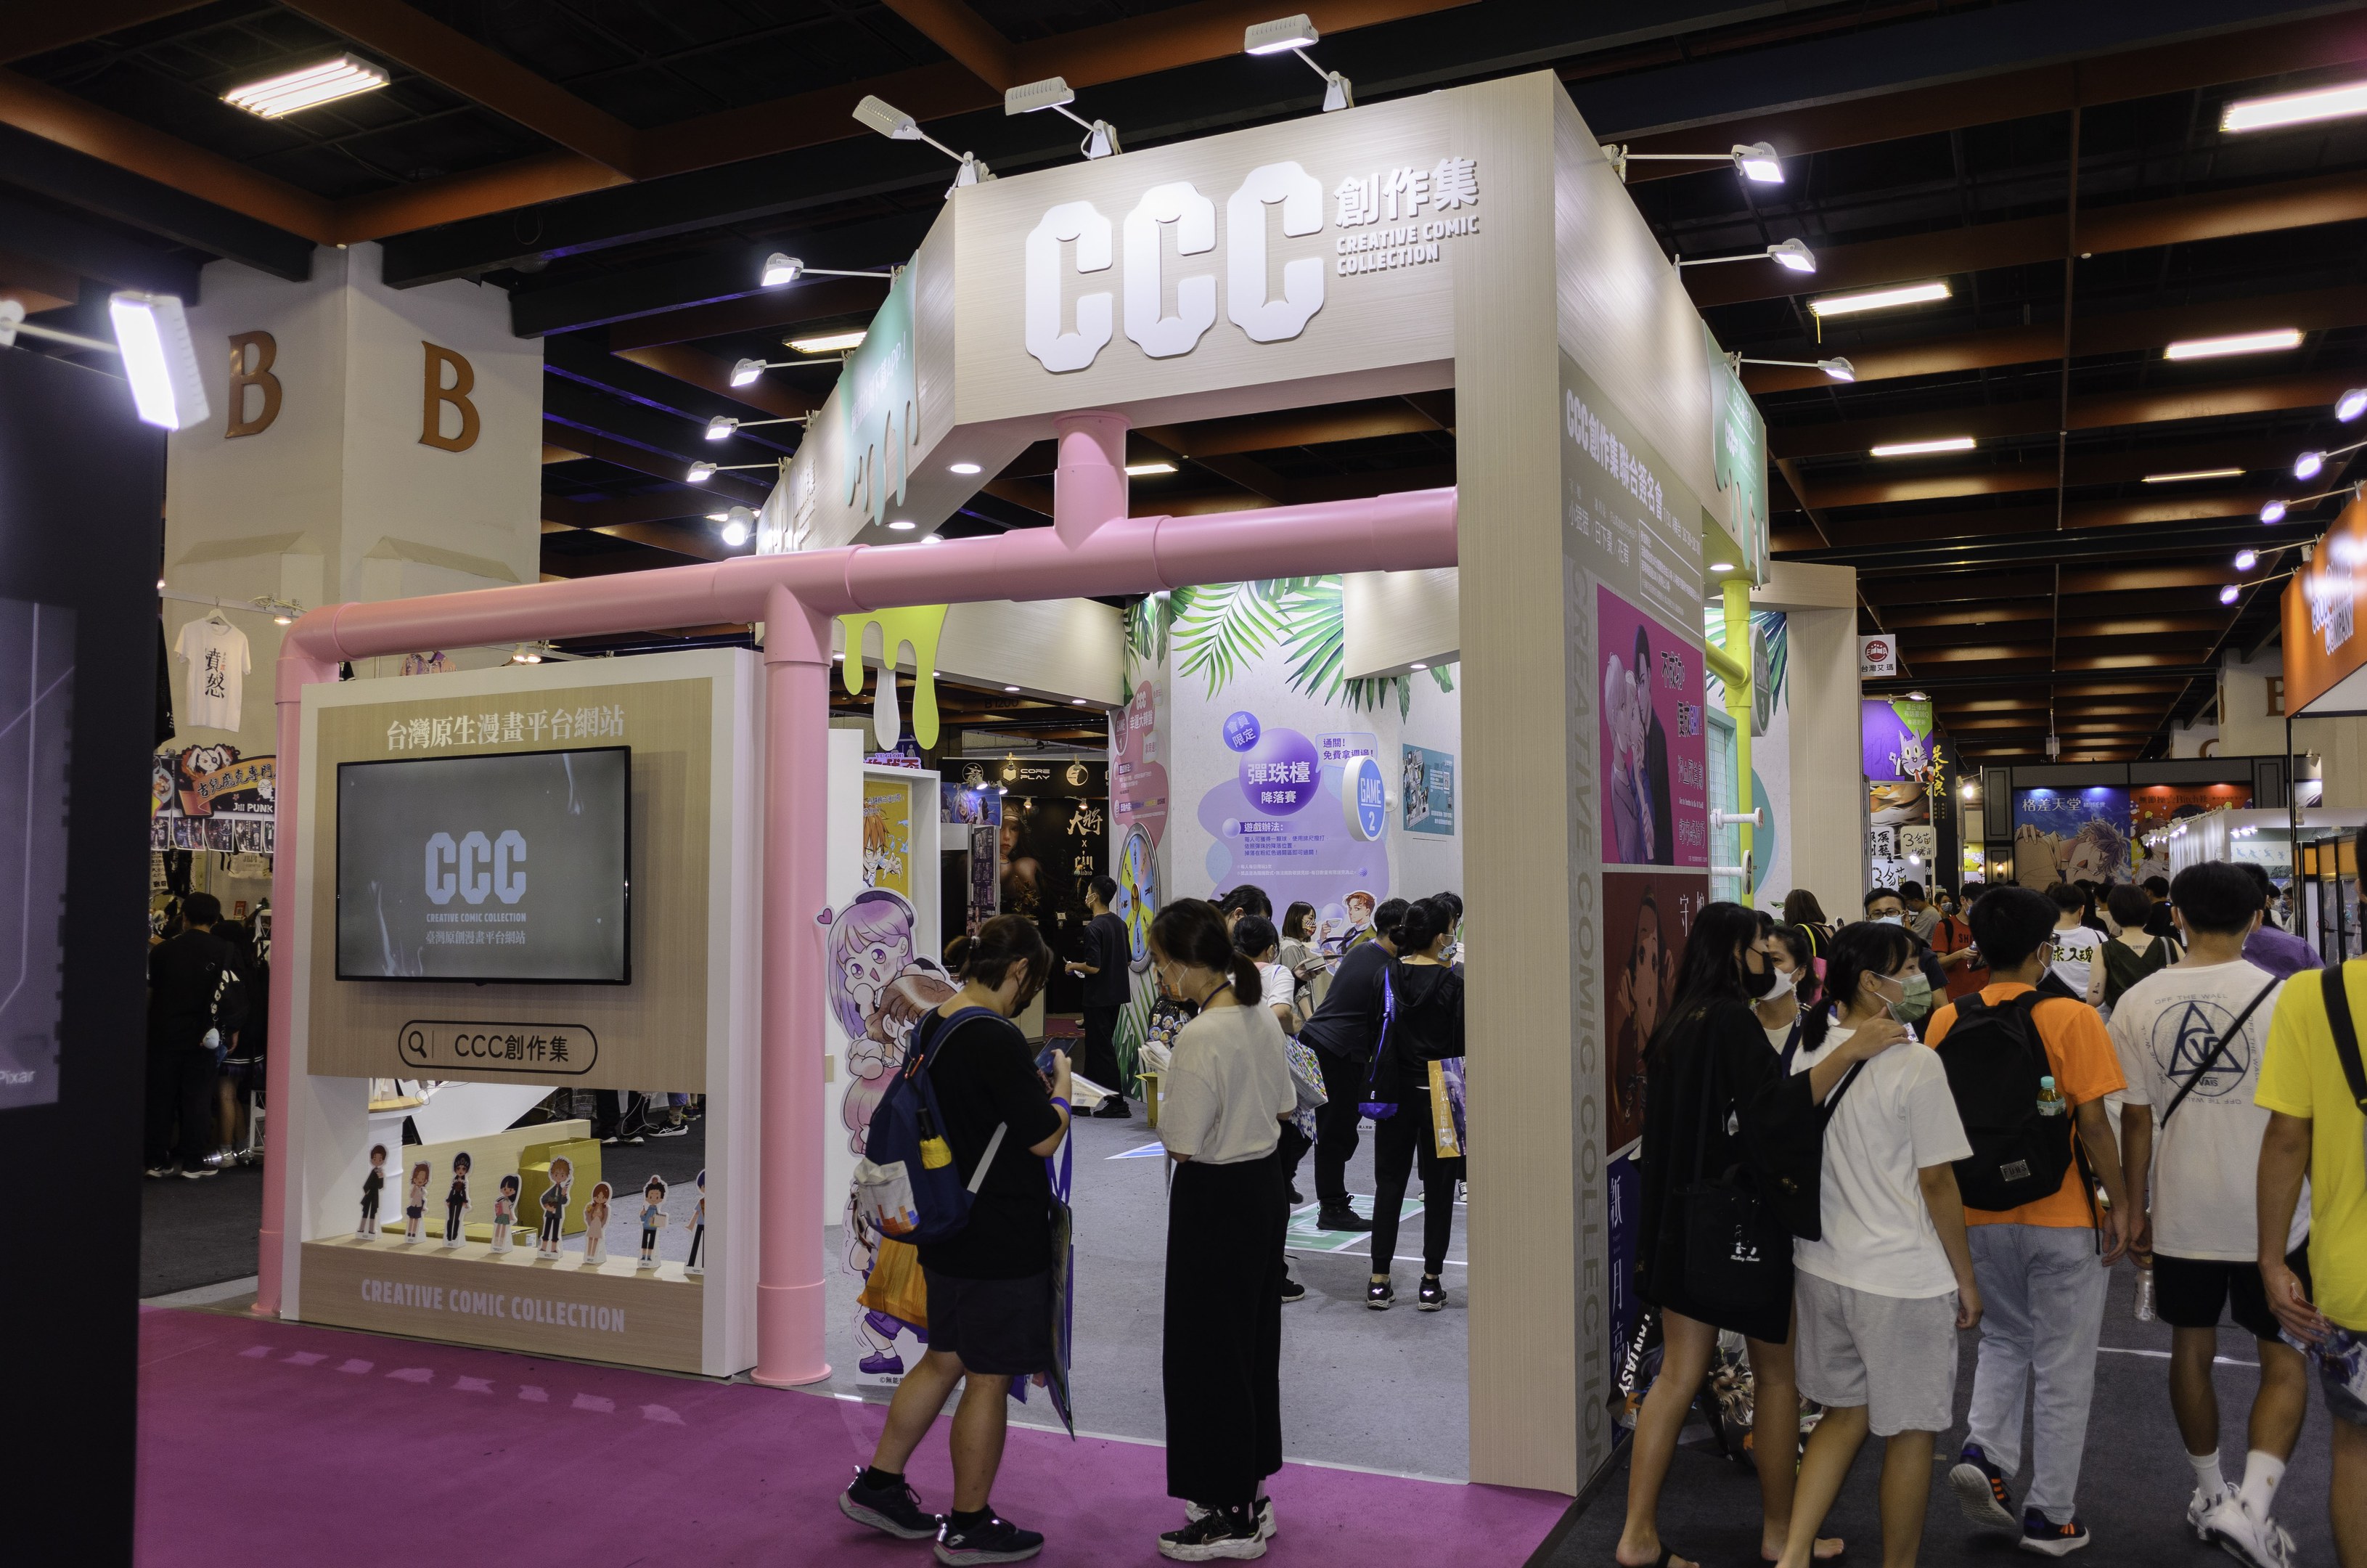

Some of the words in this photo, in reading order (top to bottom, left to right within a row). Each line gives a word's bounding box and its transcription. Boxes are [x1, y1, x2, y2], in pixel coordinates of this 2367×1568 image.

[1333, 157, 1479, 228] 創作集
[1336, 226, 1418, 256] CREATIVE
[1422, 215, 1480, 238] COMIC
[1025, 160, 1325, 373] CCC
[1336, 243, 1439, 276] COLLECTION
[224, 330, 282, 438] B
[418, 340, 481, 452] B
[1566, 388, 1662, 522] CCC創作集聯合簽名會
[1861, 663, 1894, 672] 台灣艾瑪
[387, 704, 625, 751] 台灣原生漫畫平台網站
[1227, 714, 1250, 734] 會員
[1232, 728, 1256, 748] 限定
[1119, 737, 1123, 750] 1
[197, 764, 276, 798] 吉兒龐克專門
[1248, 761, 1311, 785] 彈珠檯
[1261, 791, 1296, 804] 降落賽
[1360, 778, 1382, 804] GAME
[2021, 797, 2082, 812] 格差天堂
[233, 802, 245, 811] Jill
[248, 803, 273, 813] PUNK
[1368, 811, 1375, 831] 2
[425, 830, 526, 905] CCC
[426, 913, 459, 923] CREATIVE
[460, 913, 483, 923] COMIC
[484, 912, 526, 923] COLLECTION
[425, 931, 526, 944] 臺灣原創漫畫平台網站
[1576, 870, 1596, 1075] COMIC
[455, 1033, 569, 1063] CCC創作集
[361, 1278, 443, 1310] CREATIVE
[449, 1289, 505, 1319] COMIC
[510, 1296, 625, 1334] COLLECTION
